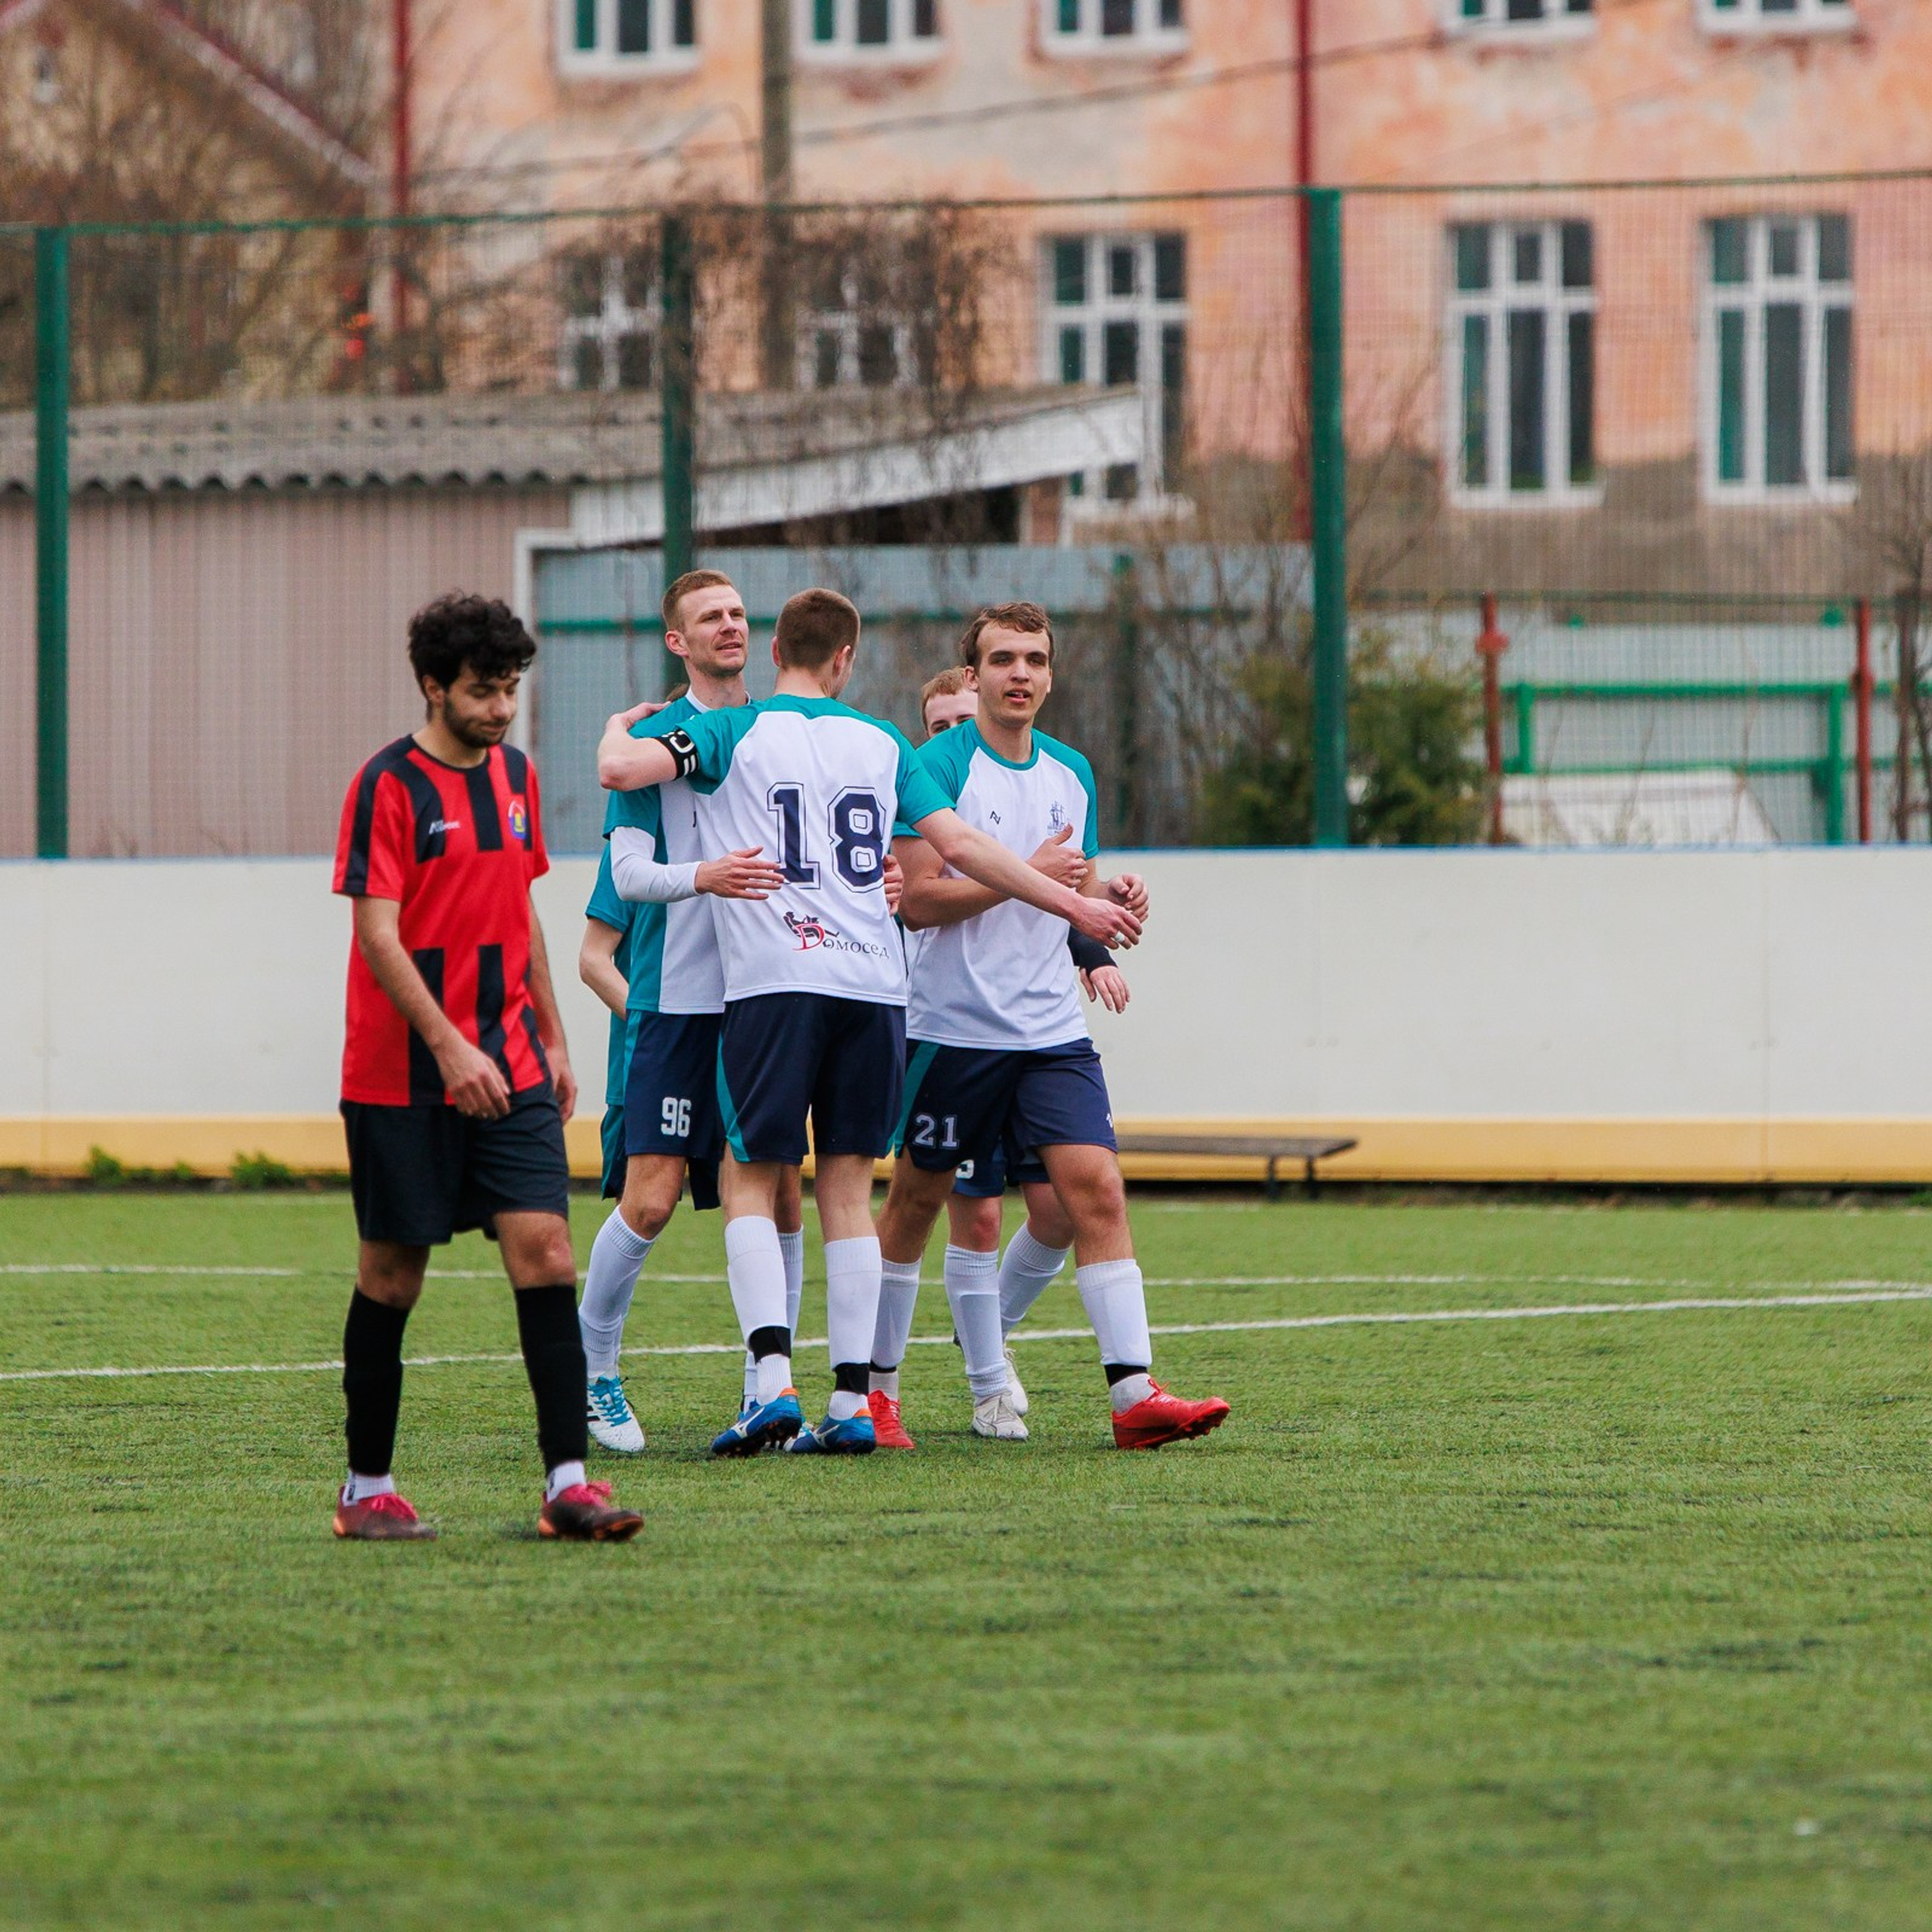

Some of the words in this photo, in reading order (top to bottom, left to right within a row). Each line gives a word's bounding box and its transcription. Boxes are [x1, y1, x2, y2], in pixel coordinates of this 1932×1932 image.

[767, 782, 887, 893] 18
[661, 1097, 691, 1137] 96
[913, 1114, 959, 1149] 21
